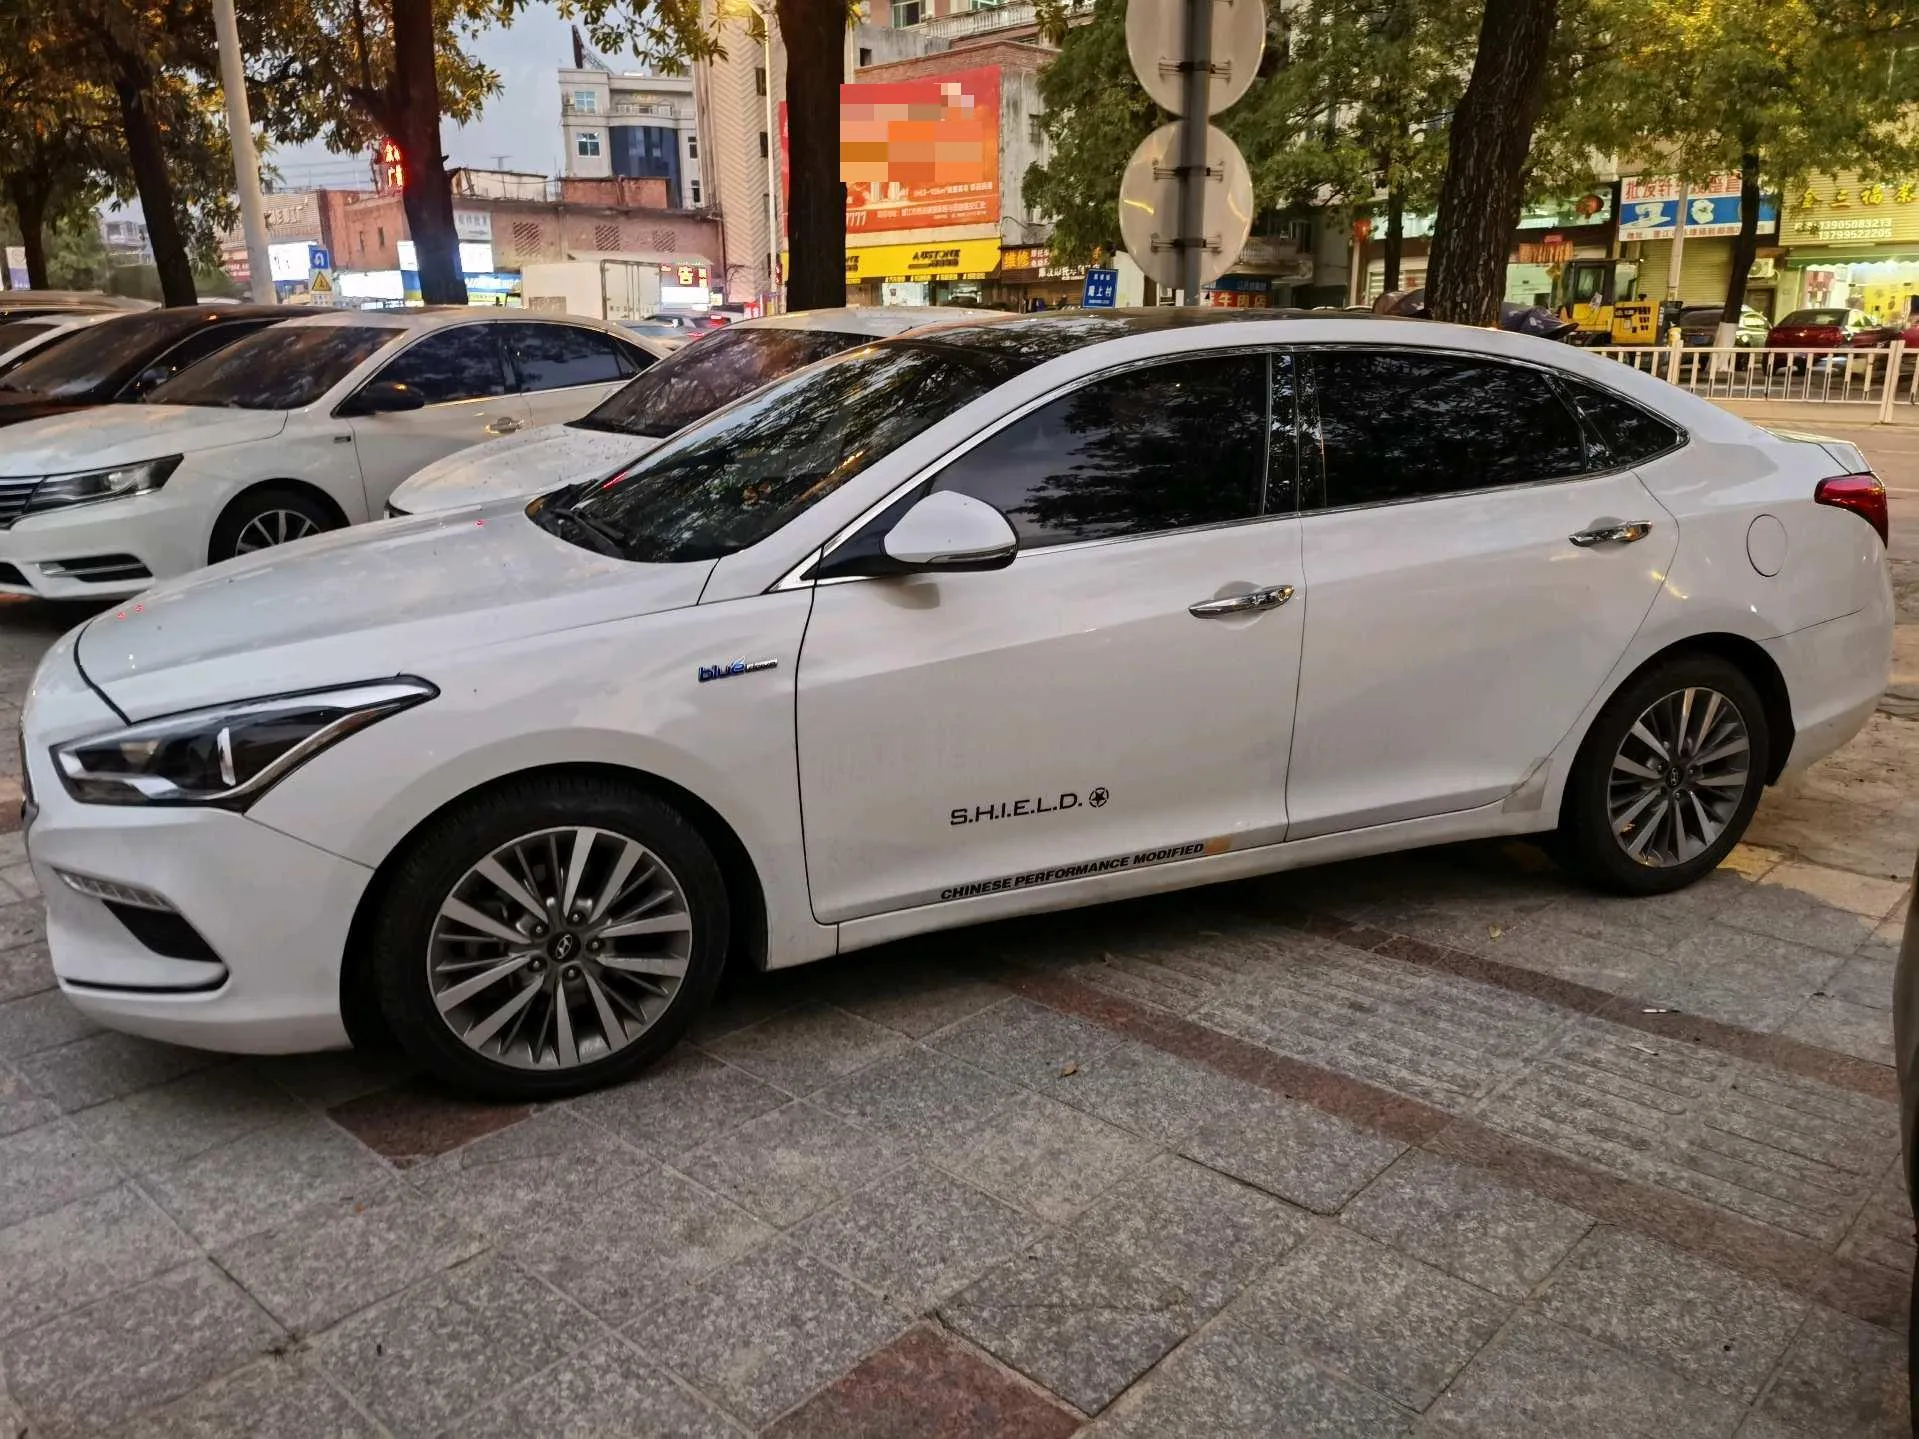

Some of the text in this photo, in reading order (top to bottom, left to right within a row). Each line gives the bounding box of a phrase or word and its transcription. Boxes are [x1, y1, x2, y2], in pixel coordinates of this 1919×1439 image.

[698, 658, 745, 683] blue
[950, 792, 1084, 826] S.H.I.E.L.D.
[940, 842, 1205, 902] CHINESE PERFORMANCE MODIFIED
